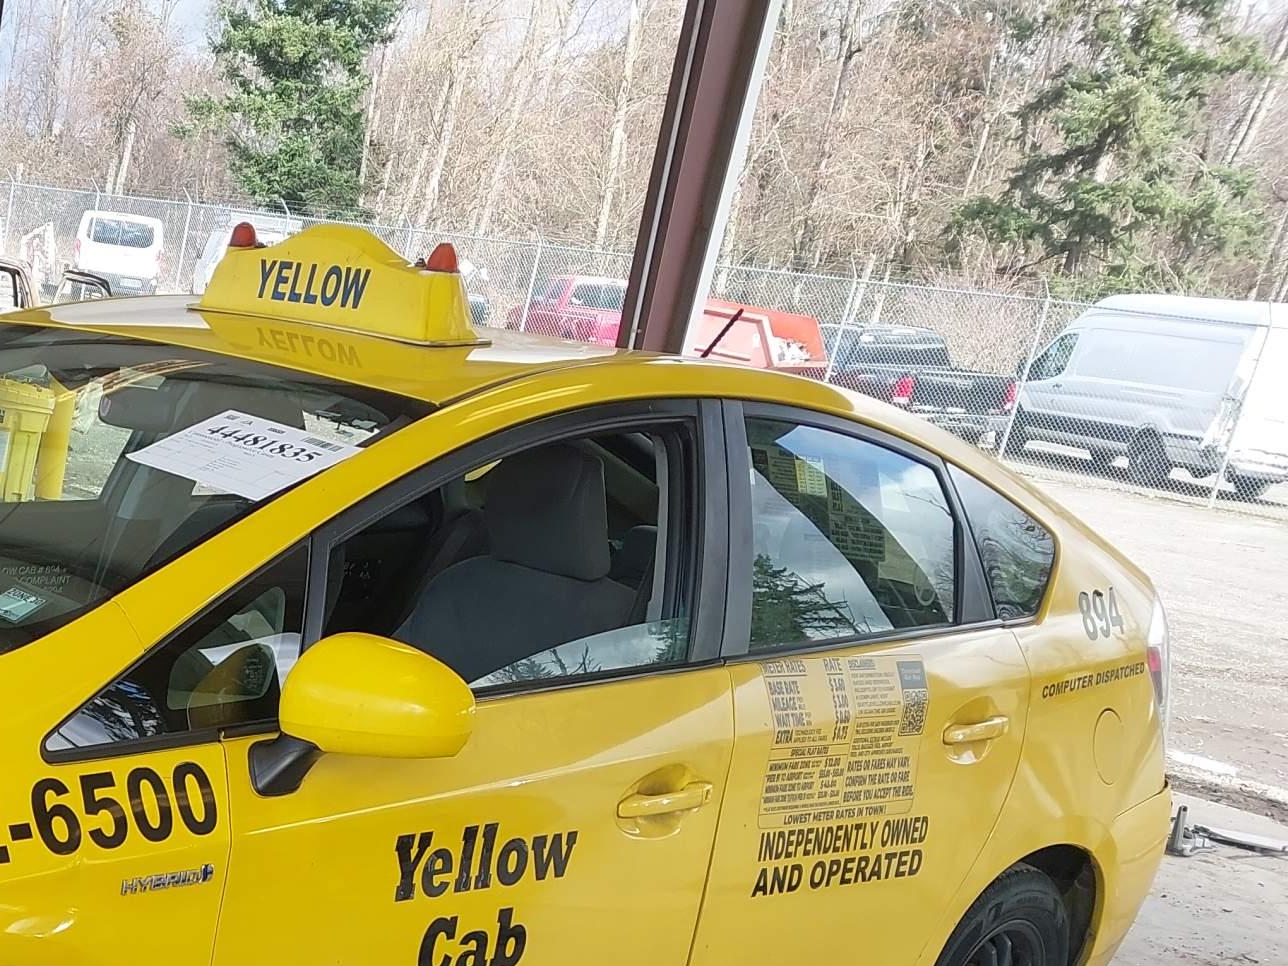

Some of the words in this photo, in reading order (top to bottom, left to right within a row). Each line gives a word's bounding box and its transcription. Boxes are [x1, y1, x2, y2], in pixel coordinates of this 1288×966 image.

[256, 258, 372, 309] YELLOW
[208, 425, 323, 463] 44481835
[1078, 587, 1124, 641] 894
[823, 658, 842, 672] RATE
[1042, 674, 1093, 699] COMPUTER
[1096, 662, 1145, 685] DISPATCHED
[768, 681, 785, 695] BASE
[784, 680, 800, 694] RATE
[775, 729, 793, 744] EXTRA
[847, 759, 863, 773] RATES
[863, 759, 871, 771] OR
[871, 758, 886, 770] FARES
[886, 757, 897, 769] MAY
[783, 812, 811, 826] LOWEST
[813, 810, 834, 823] METER
[835, 808, 856, 820] RATES
[856, 807, 864, 817] IN
[758, 820, 880, 861] INDEPENDENTLY
[880, 816, 930, 848] OWNED
[394, 822, 579, 902] Yellow
[751, 863, 803, 898] AND
[809, 849, 923, 890] OPERATED
[120, 869, 201, 896] HYBRID
